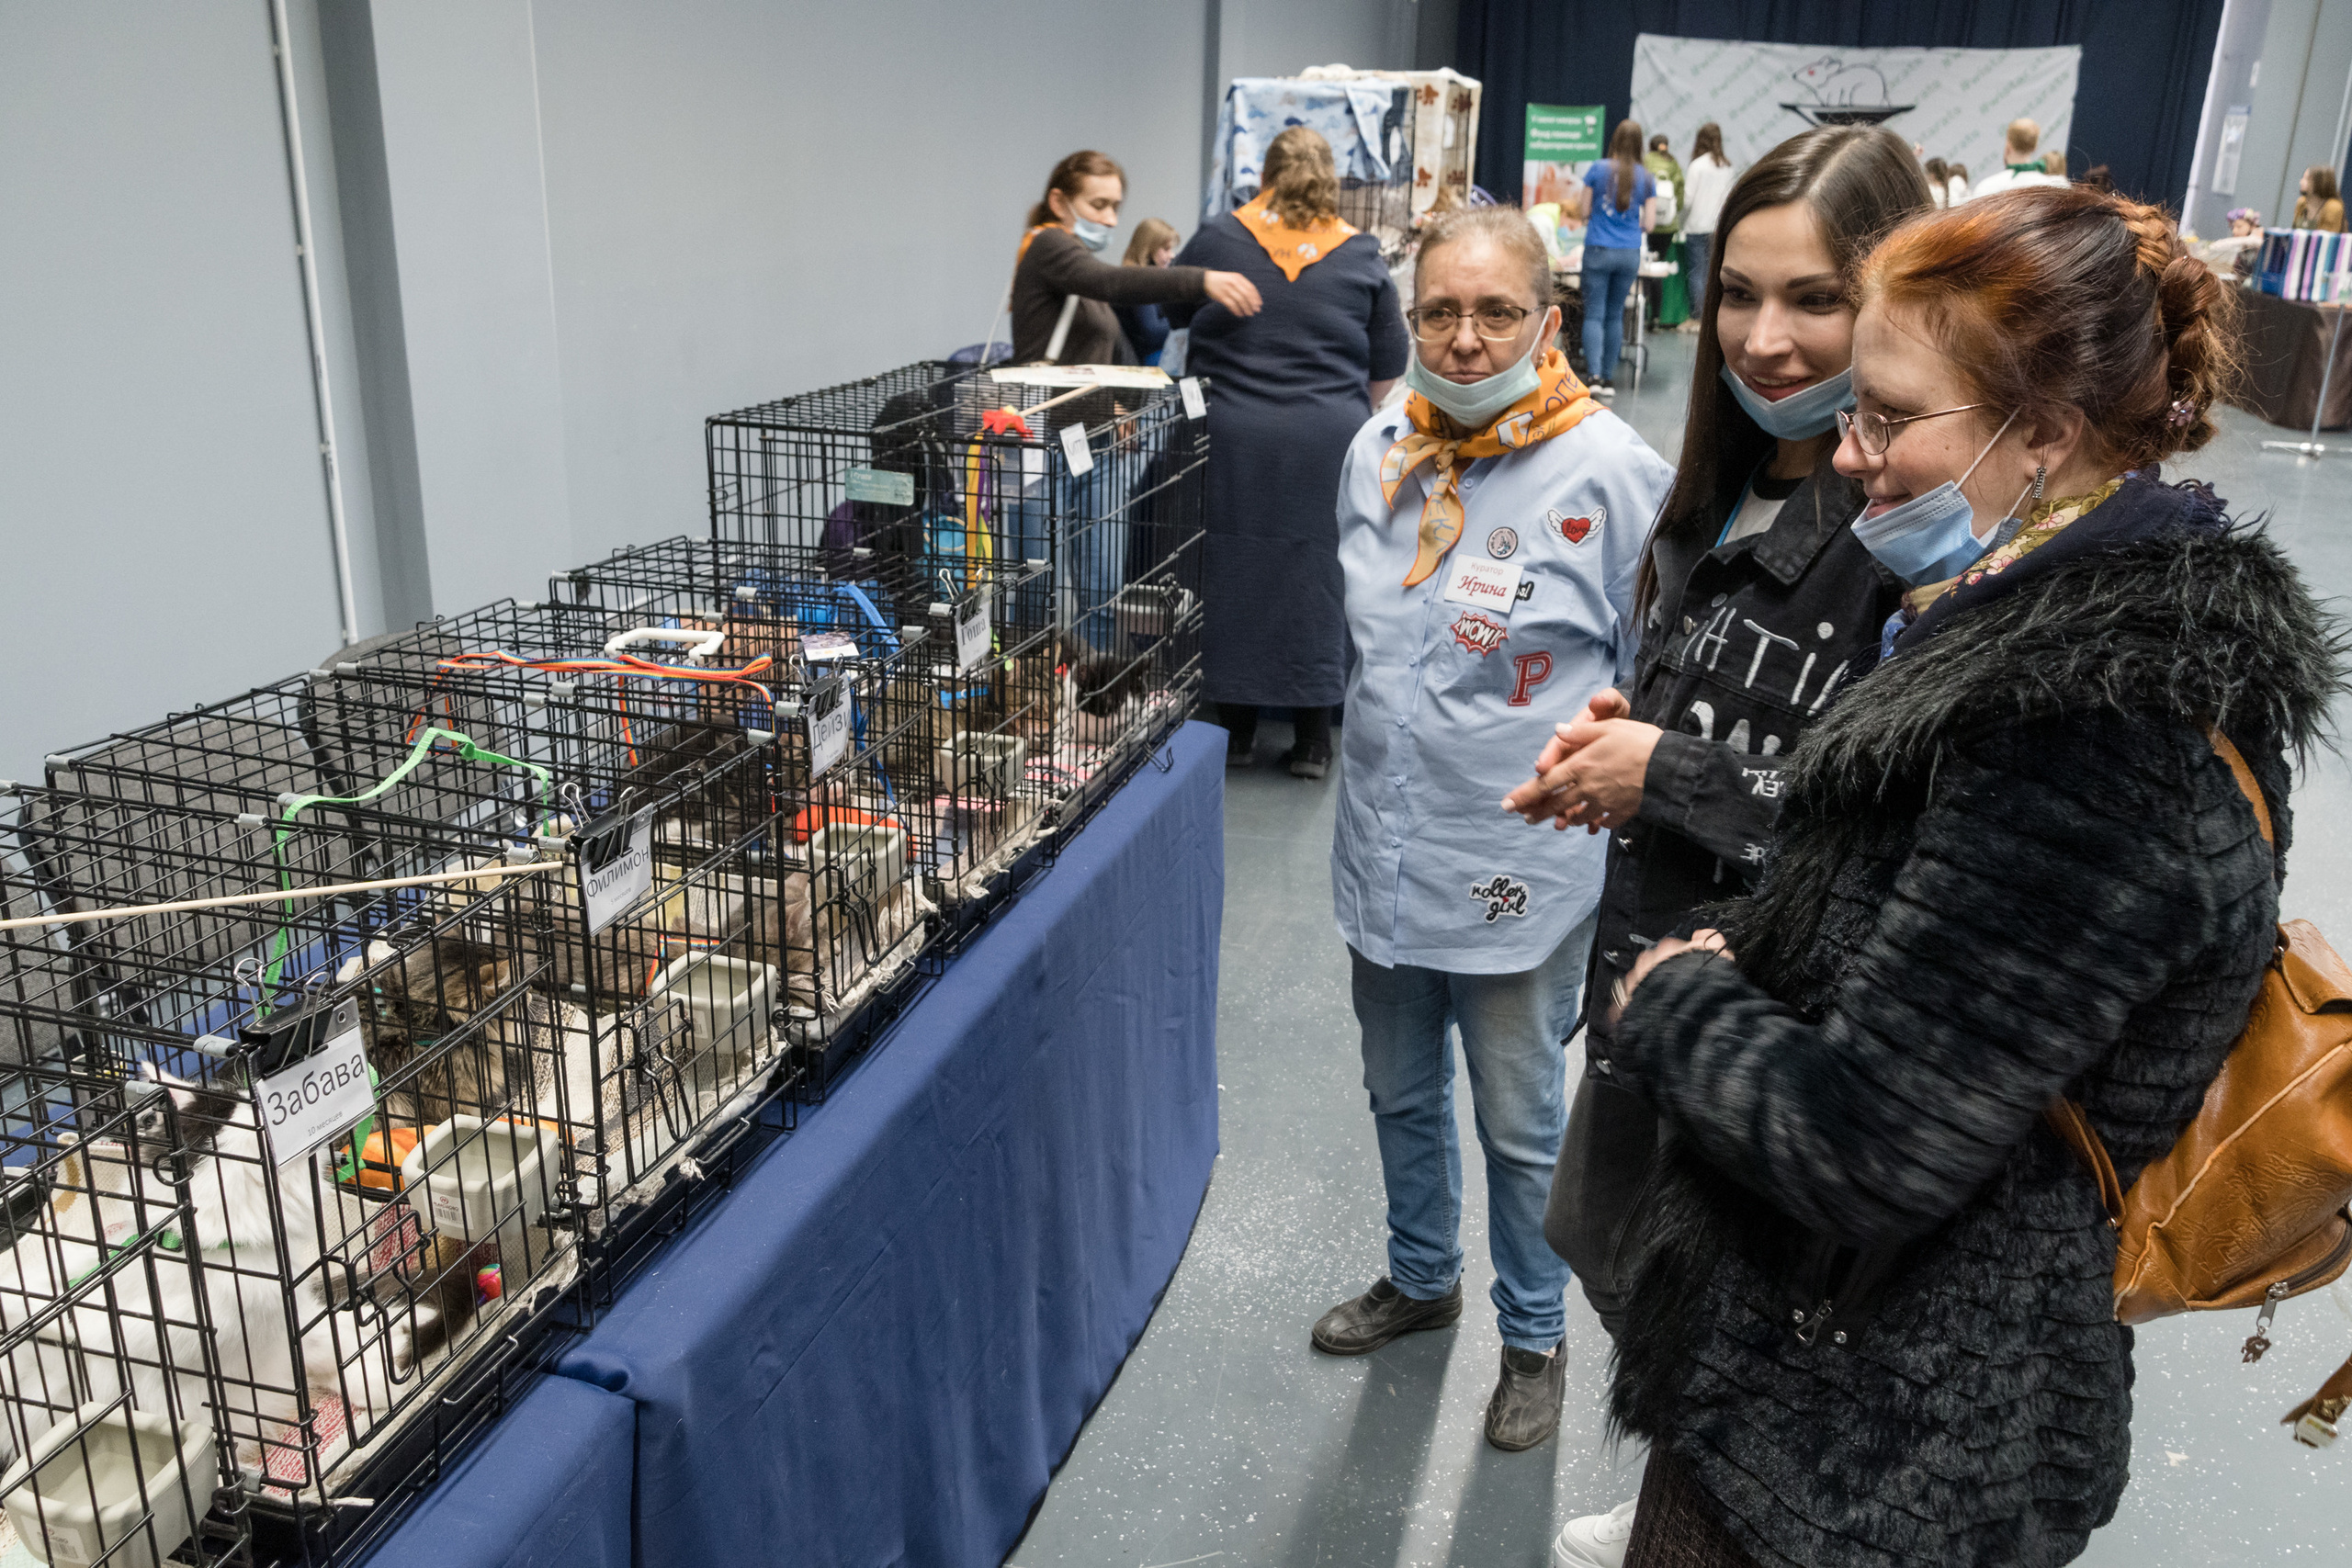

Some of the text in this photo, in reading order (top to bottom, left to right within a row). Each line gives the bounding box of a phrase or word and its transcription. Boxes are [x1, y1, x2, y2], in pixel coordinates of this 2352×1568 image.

[1566, 521, 1588, 536] love
[1470, 561, 1505, 576] Куратор
[1457, 575, 1508, 598] Ирина
[961, 617, 986, 647] Гоша
[1472, 877, 1526, 898] roller
[1486, 894, 1527, 921] girl
[267, 1054, 365, 1126] Забава
[308, 1111, 344, 1137] 10 месяцев
